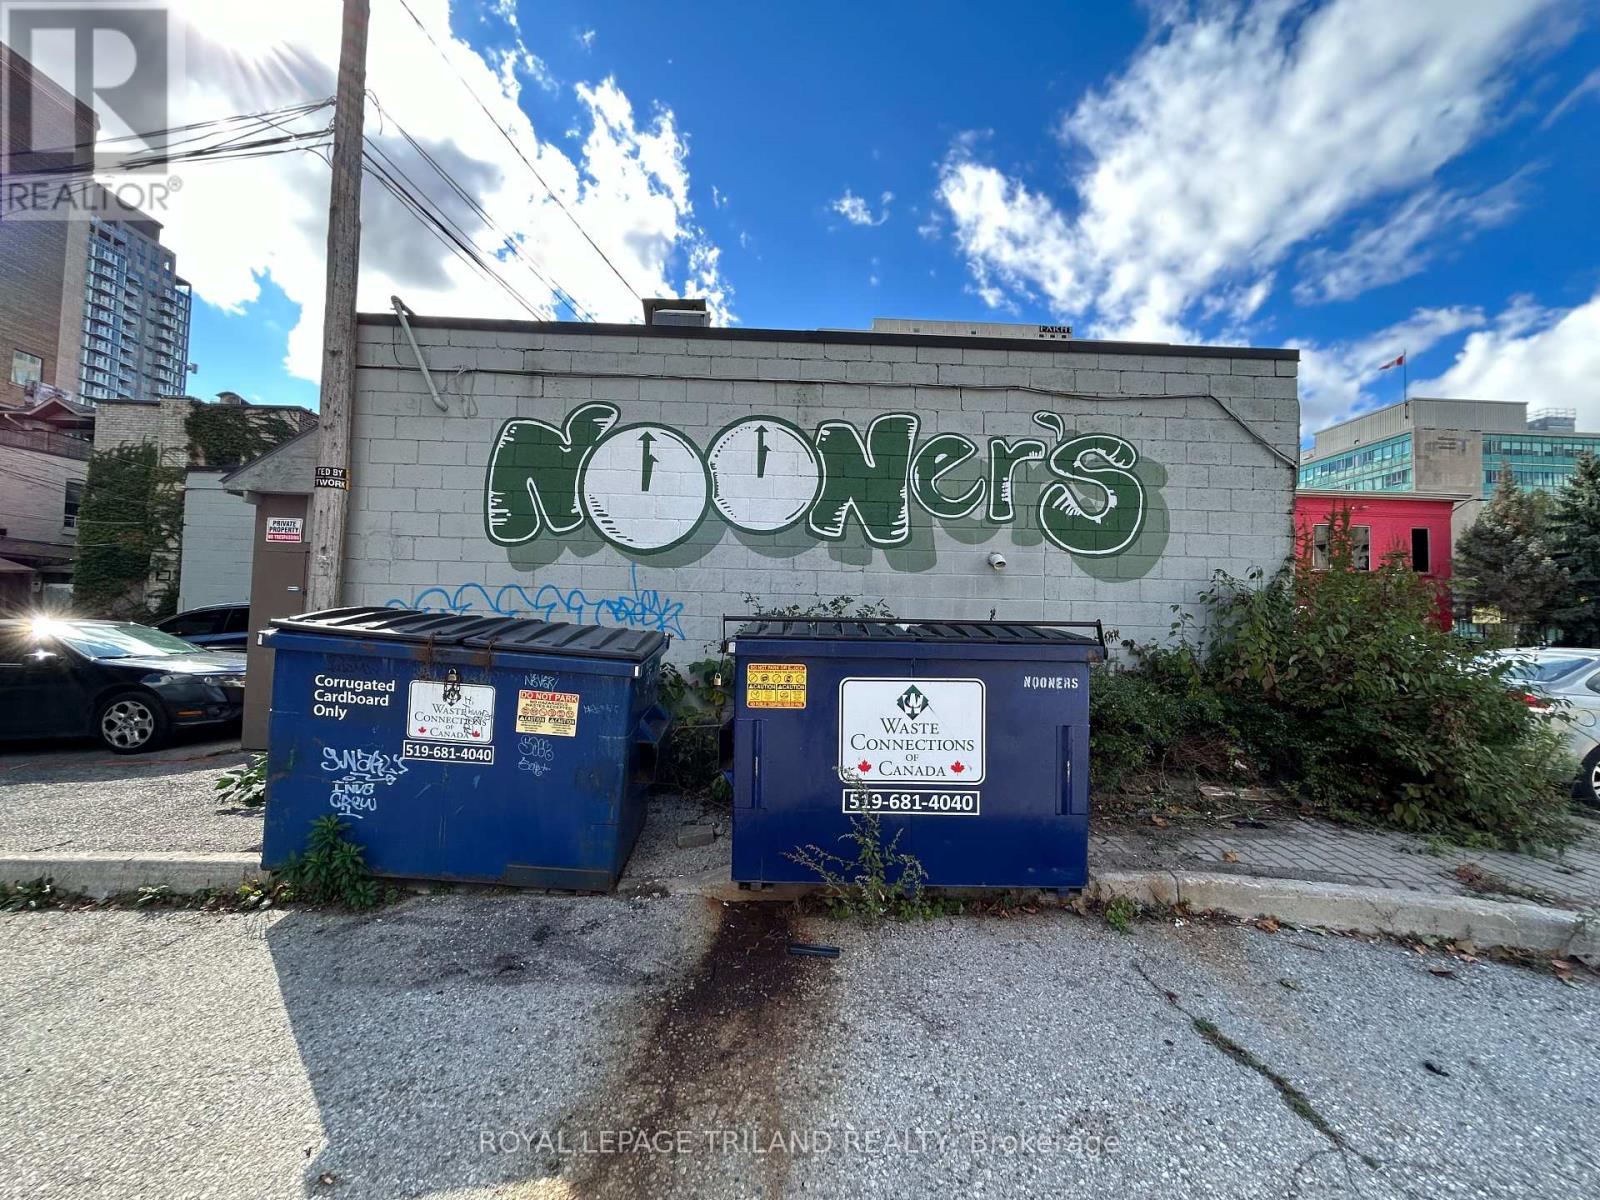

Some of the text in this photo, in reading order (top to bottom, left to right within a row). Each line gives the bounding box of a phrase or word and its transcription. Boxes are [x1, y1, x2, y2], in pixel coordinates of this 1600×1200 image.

[332, 468, 344, 477] BY
[272, 520, 297, 528] PRIVATE
[314, 674, 396, 693] Corrugated
[1023, 675, 1079, 689] NOONERS
[314, 689, 389, 707] Cardboard
[521, 691, 578, 704] DO NOT PARK
[313, 703, 347, 721] Only
[432, 703, 467, 716] WASTE
[414, 710, 487, 727] CONNECTIONS
[880, 717, 939, 735] WASTE
[430, 727, 470, 739] CANADA
[850, 733, 975, 752] CONNECTIONS
[405, 743, 492, 761] 519-681-4040
[905, 753, 919, 762] OF
[878, 760, 947, 777] CANADA
